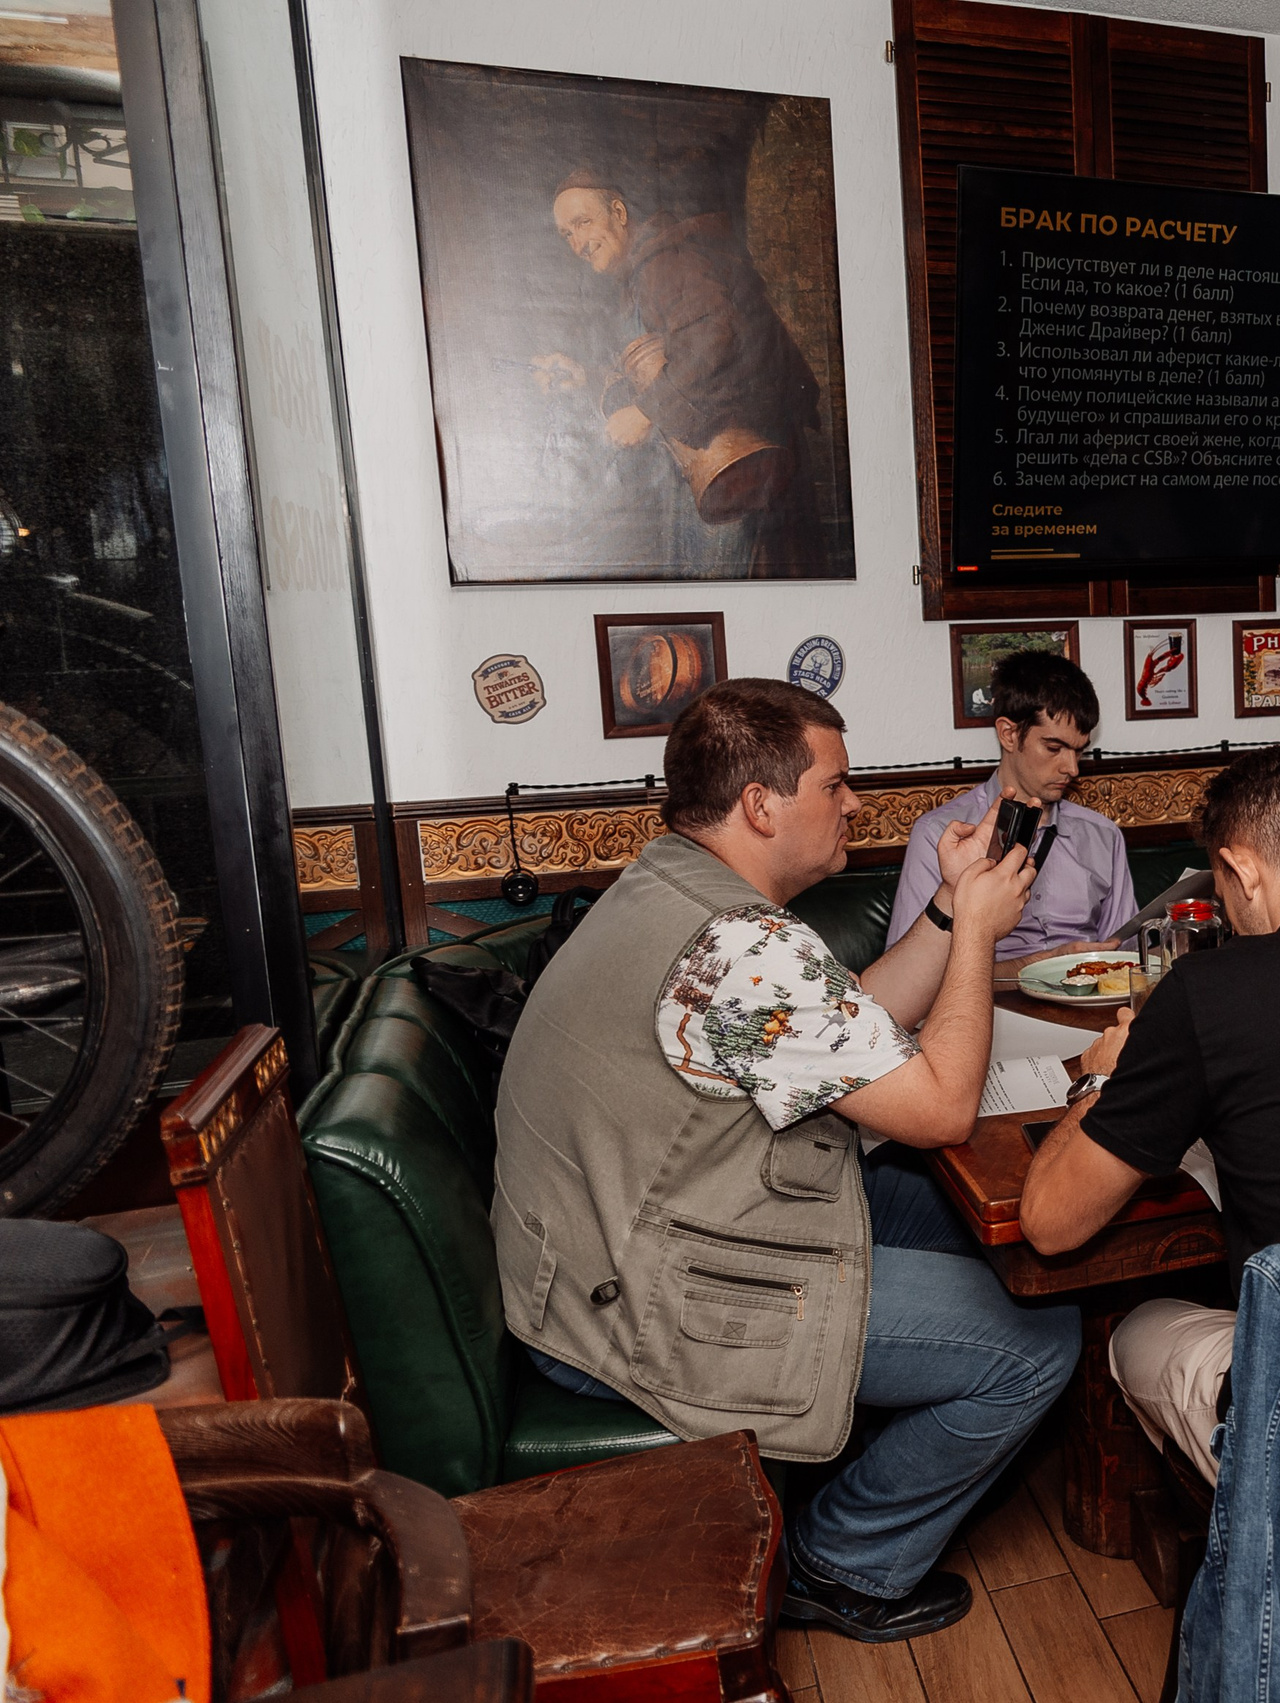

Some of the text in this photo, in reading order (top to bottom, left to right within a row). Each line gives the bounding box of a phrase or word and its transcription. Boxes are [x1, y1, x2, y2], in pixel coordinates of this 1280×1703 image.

[1000, 207, 1238, 245] БРАК ПО РАСЧЕТУ
[1000, 249, 1013, 267] 1.
[1022, 251, 1136, 278] Присутствует
[1139, 261, 1160, 276] ли
[1164, 265, 1173, 277] в
[1176, 266, 1215, 281] деле
[1022, 273, 1234, 304] Если да, то какое? (1 балл)
[998, 296, 1011, 312] 2.
[1021, 296, 1086, 320] Почему
[1090, 305, 1163, 323] возврата
[1167, 309, 1216, 325] денег,
[1220, 312, 1272, 326] взятых
[1019, 318, 1232, 345] Дженис Драйвер? (1 балл)
[996, 341, 1010, 357] 3.
[1020, 341, 1128, 362] Использовал
[1132, 350, 1152, 362] ли
[1156, 347, 1222, 368] аферист
[1019, 366, 1265, 388] что упомянуты в деле? (1 балл)
[995, 385, 1009, 400] 4.
[1018, 385, 1082, 407] Почему
[1086, 390, 1192, 407] полицейские
[1196, 394, 1268, 407] называли
[1017, 405, 1105, 426] будущего»
[1110, 412, 1119, 423] и
[1124, 412, 1220, 428] спрашивали
[1224, 414, 1249, 426] его
[1252, 415, 1262, 426] о
[994, 428, 1008, 444] 5.
[1016, 428, 1054, 444] Лгал
[1058, 433, 1078, 445] ли
[1083, 429, 1150, 449] аферист
[1153, 431, 1199, 446] своей
[1202, 435, 1244, 449] жене,
[1016, 453, 1078, 468] решить
[1083, 453, 1127, 467] «дела
[1132, 454, 1140, 465] с
[1144, 450, 1187, 465] CSB»?
[1191, 450, 1272, 466] Объясните
[993, 471, 1007, 486] 6.
[1015, 471, 1065, 486] Зачем
[1069, 471, 1136, 490] аферист
[1140, 475, 1158, 486] на
[1162, 475, 1210, 486] самом
[1213, 475, 1249, 489] деле
[992, 504, 1063, 517] Следите
[992, 525, 1097, 538] за временем
[483, 672, 530, 695] THWAITES
[792, 670, 831, 688] STAG'S HEAD
[485, 681, 540, 710] BITTER
